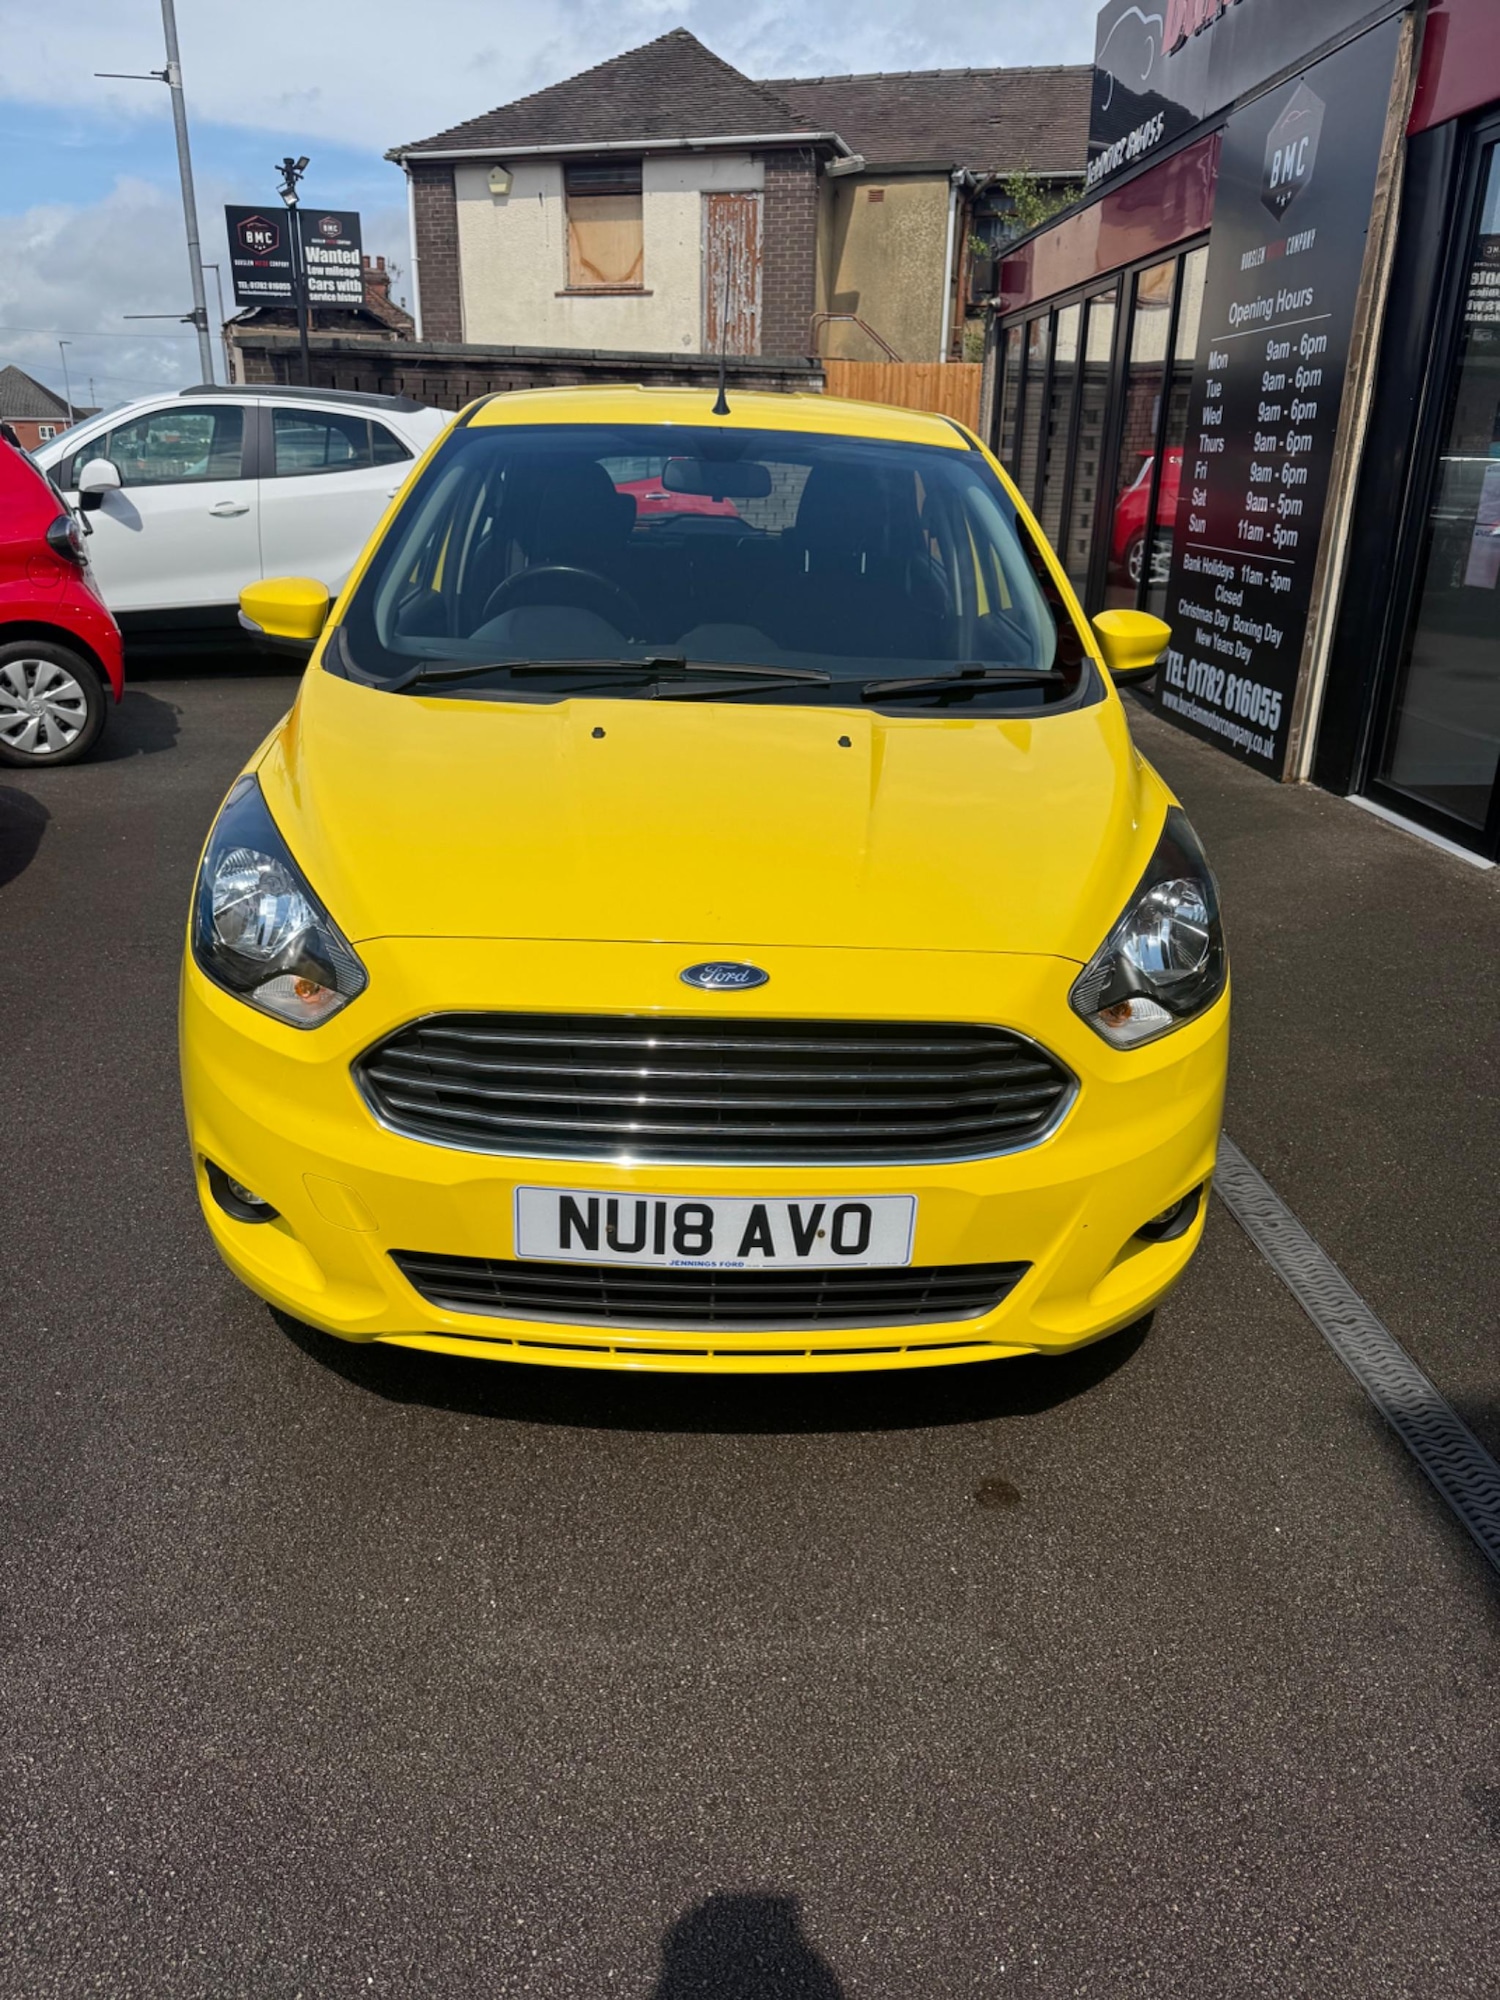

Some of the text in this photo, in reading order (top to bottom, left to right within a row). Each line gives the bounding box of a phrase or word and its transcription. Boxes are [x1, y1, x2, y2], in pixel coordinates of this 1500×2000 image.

[1270, 136, 1309, 189] BMC
[246, 230, 273, 244] BMC
[1286, 228, 1316, 256] COMPANY
[305, 246, 360, 265] Wanted
[307, 264, 360, 278] Low mileage
[308, 277, 362, 292] Cars with
[309, 292, 362, 304] service history
[1229, 287, 1314, 327] Opening Hours
[1208, 351, 1228, 370] Mon
[1266, 340, 1290, 361] 9am
[1300, 333, 1327, 360] 6pm
[1206, 379, 1222, 398] Tue
[1262, 371, 1285, 392] 9am
[1295, 366, 1322, 393] 6pm
[1202, 405, 1223, 425] Wed
[1257, 402, 1281, 422] 9am
[1291, 398, 1317, 425] 6pm
[1199, 434, 1224, 453] Thurs
[1253, 432, 1276, 452] 9am
[1286, 430, 1312, 456] 6pm
[1194, 461, 1208, 480] Fri
[1250, 462, 1272, 482] 9am
[1282, 462, 1307, 488] 6pm
[1192, 487, 1207, 507] Sat
[1246, 492, 1268, 512] 9am
[1277, 493, 1303, 519] 5pm
[1188, 514, 1206, 533] Sun
[1238, 520, 1263, 541] 11am
[1274, 523, 1298, 549] 5pm
[1183, 554, 1201, 572] Bank
[1202, 557, 1234, 583] Holidays
[1241, 565, 1263, 586] 11am
[1270, 570, 1291, 594] 5pm
[1215, 584, 1243, 606] Closed
[1178, 599, 1283, 649] Christmas Day Boxing Day
[1195, 628, 1252, 665] New Years Day
[1165, 651, 1282, 731] TEL: 01782 816055
[700, 965, 750, 982] Ford
[559, 1196, 872, 1257] NU18 AVO
[669, 1260, 717, 1268] JENNINGS
[719, 1260, 744, 1268] FORD
